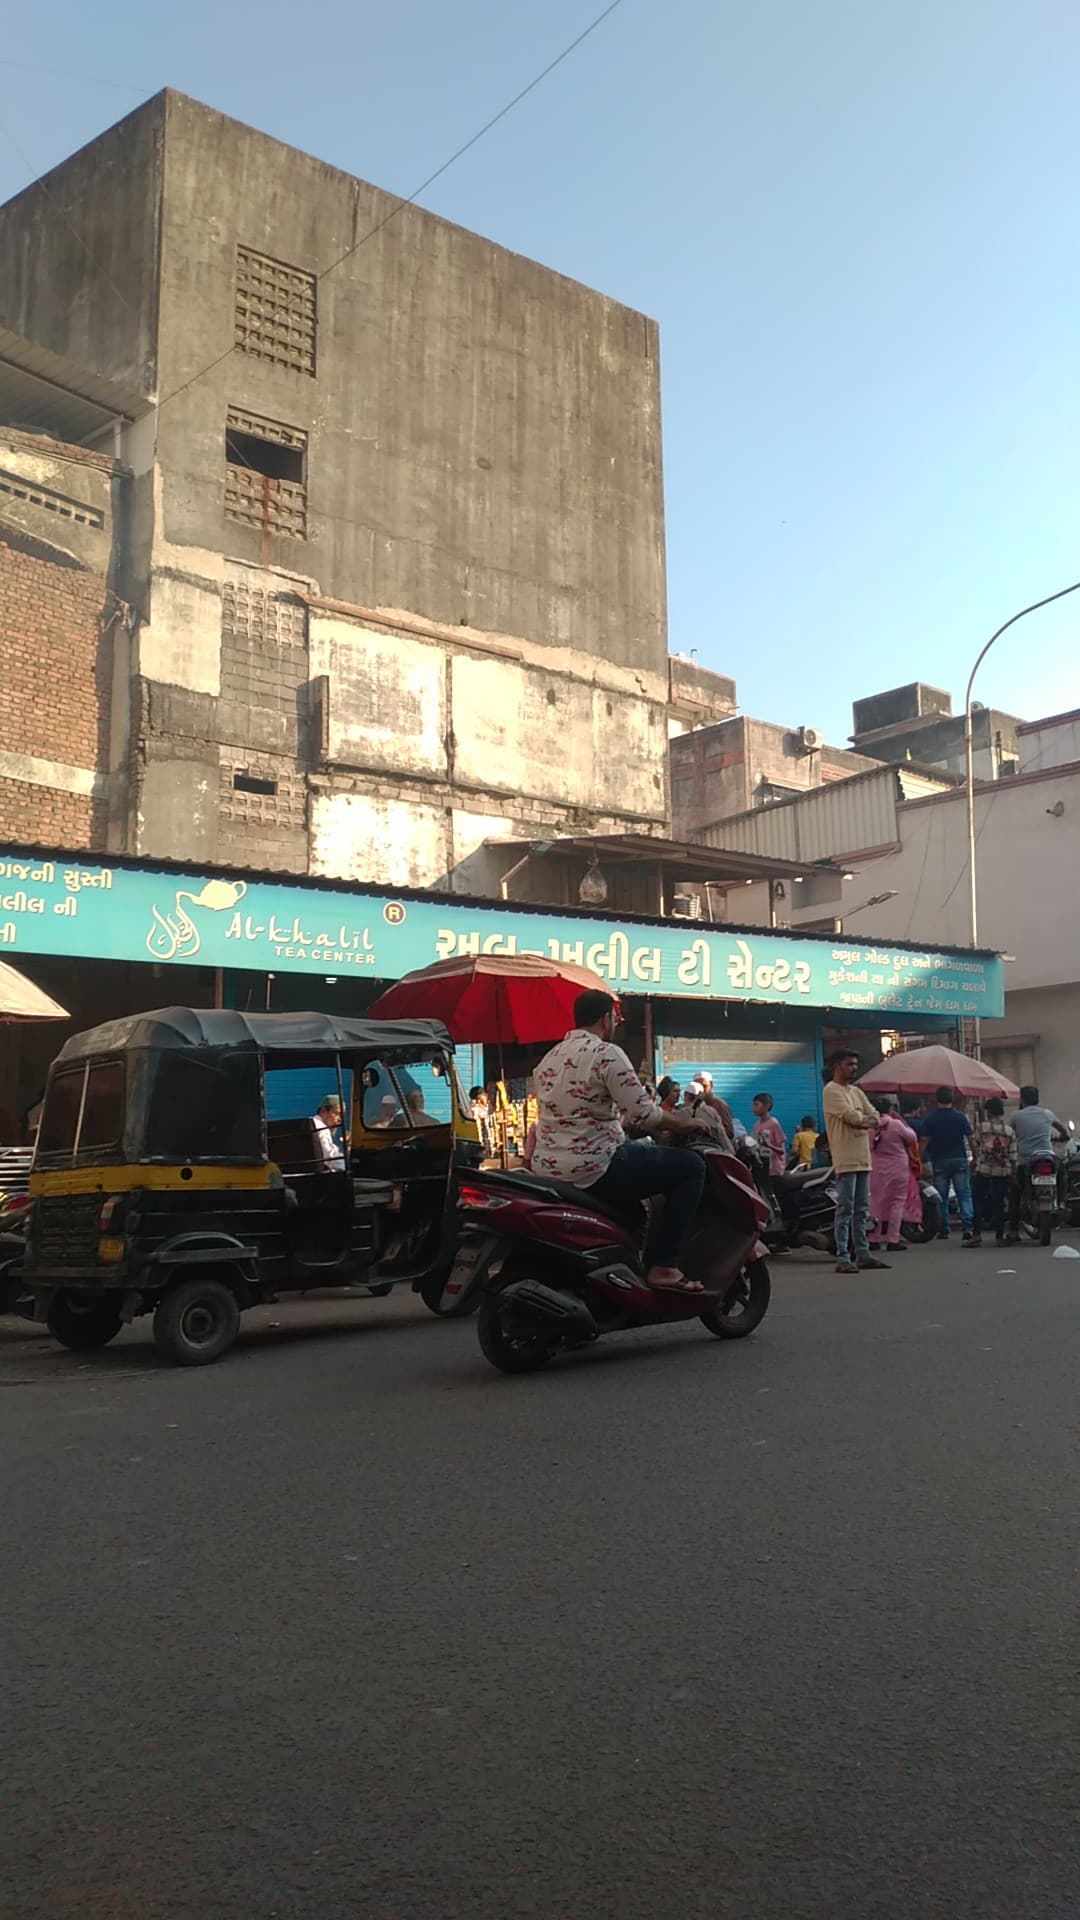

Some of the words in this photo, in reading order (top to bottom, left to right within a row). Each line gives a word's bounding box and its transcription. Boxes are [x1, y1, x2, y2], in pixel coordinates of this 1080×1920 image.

[64, 869, 112, 892] સુસ્તી
[0, 891, 45, 913] લીલ
[54, 896, 77, 917] ની
[275, 946, 307, 959] TEA
[311, 949, 376, 965] CENTER
[677, 939, 711, 986] ટી
[727, 940, 811, 993] સેન્ટર
[832, 949, 861, 966] અમુલ
[912, 954, 931, 969] અને
